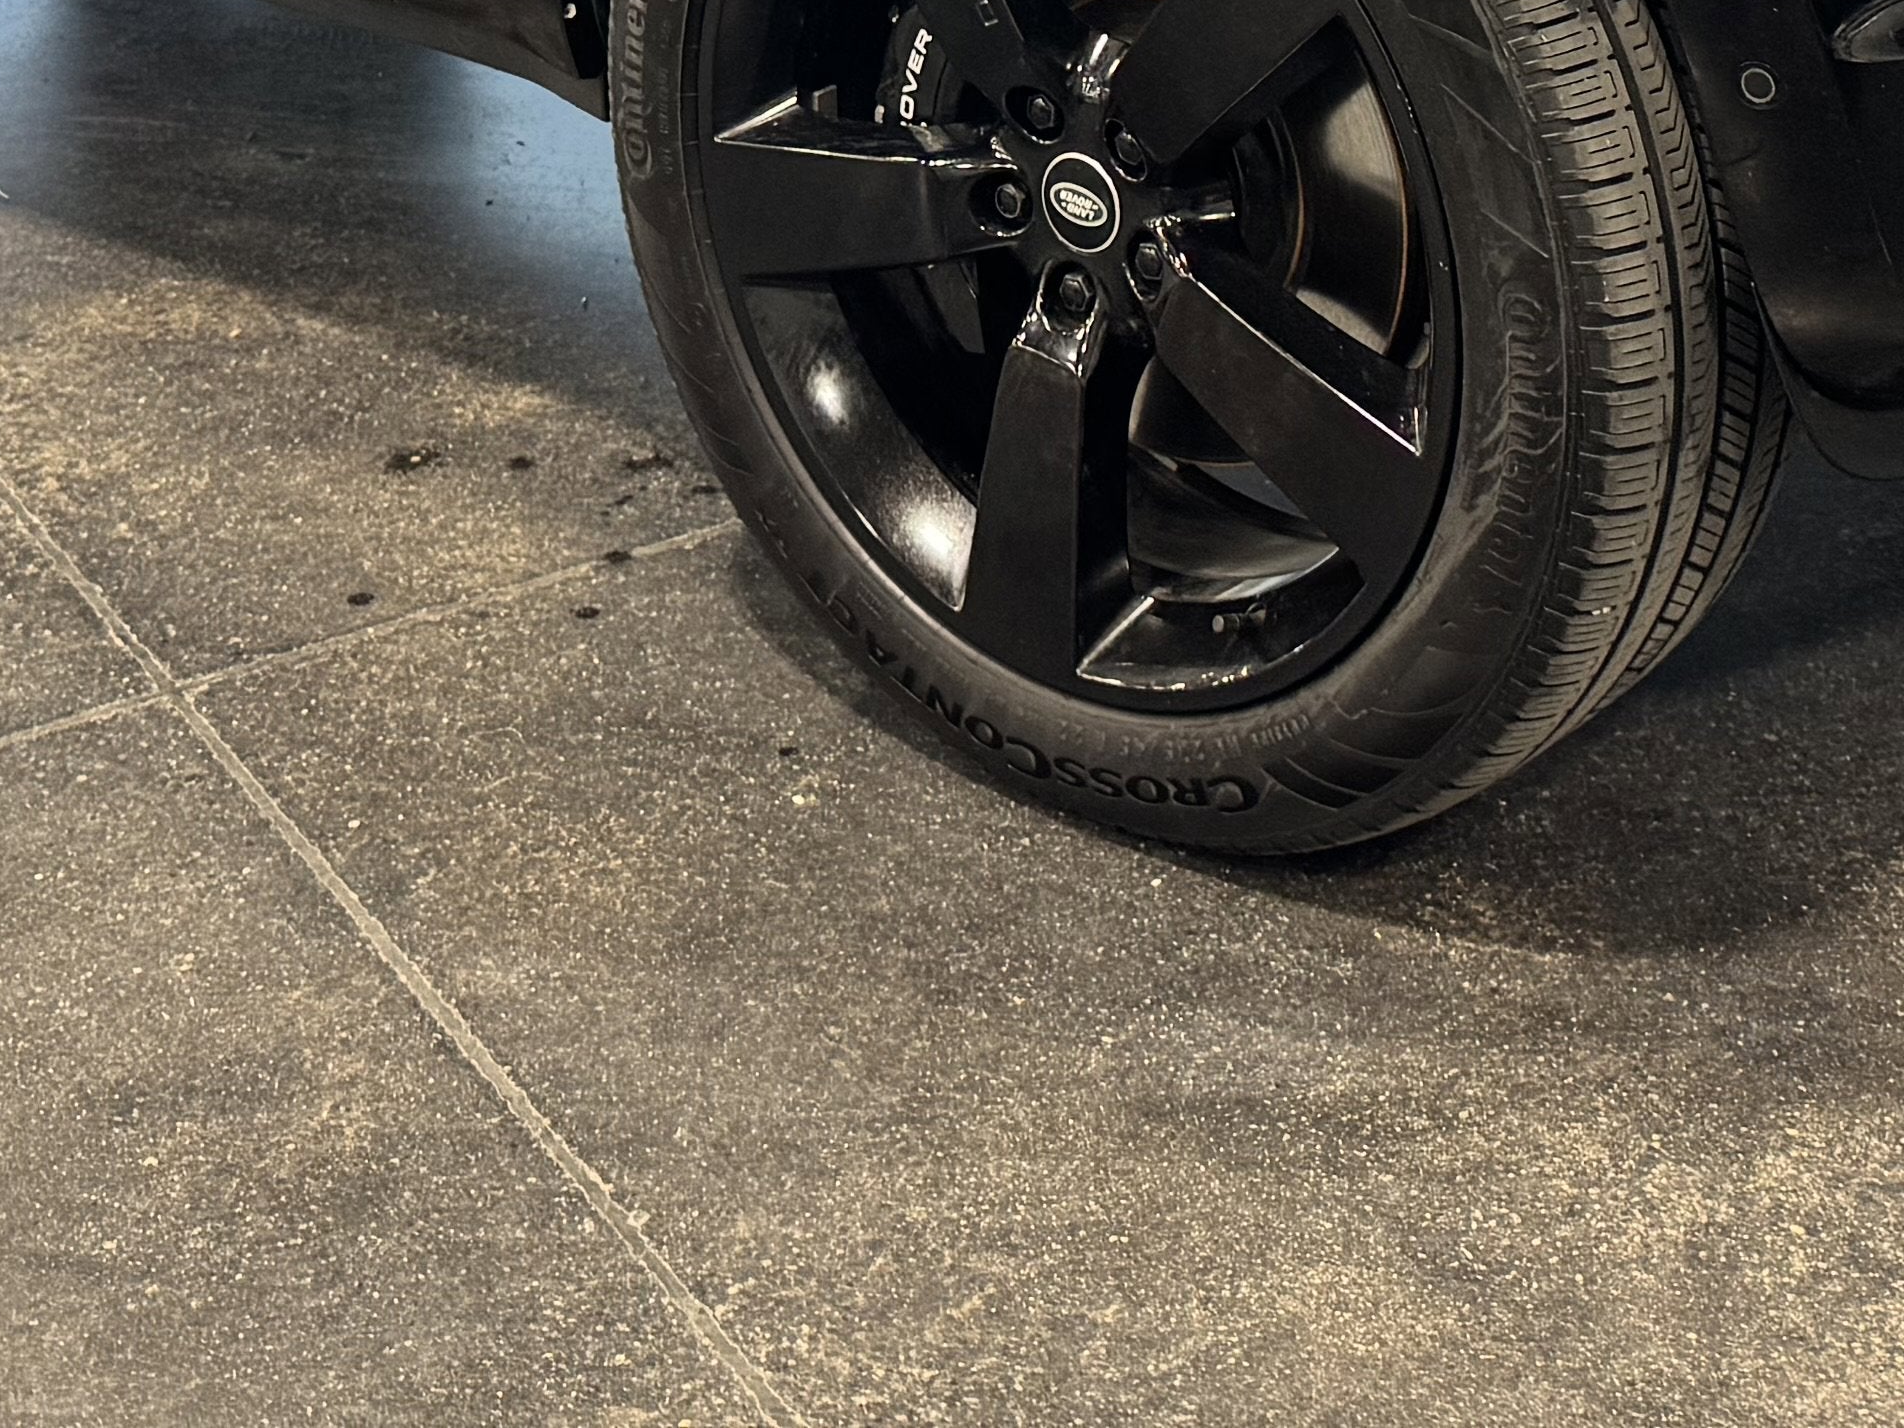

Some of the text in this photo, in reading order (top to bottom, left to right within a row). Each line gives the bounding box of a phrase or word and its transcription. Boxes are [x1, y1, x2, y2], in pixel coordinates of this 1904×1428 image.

[899, 27, 933, 127] OVER
[1059, 189, 1095, 210] ROVER
[1065, 202, 1095, 221] LAND
